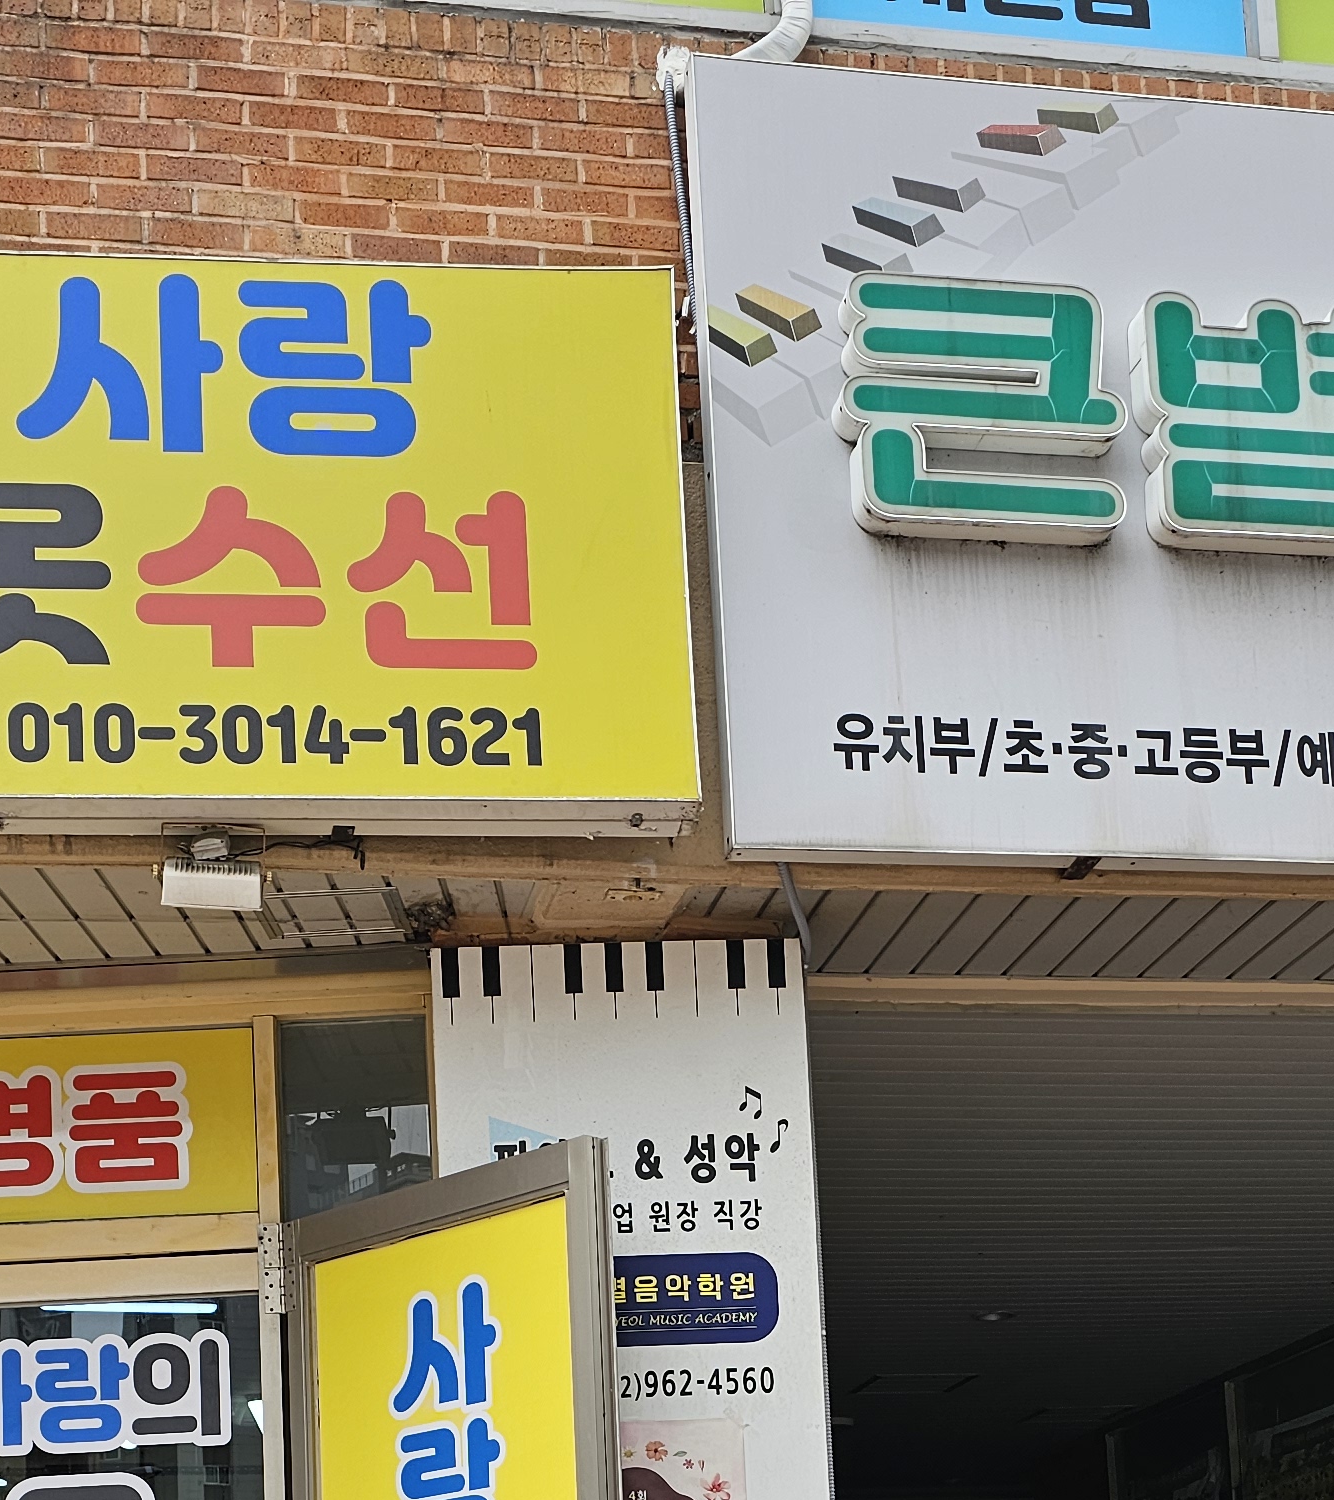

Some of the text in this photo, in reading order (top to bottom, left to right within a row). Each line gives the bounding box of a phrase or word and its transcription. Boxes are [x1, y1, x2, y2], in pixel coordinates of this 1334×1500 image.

[17, 272, 432, 458] 사랑
[8, 702, 544, 768] 010-3014-1621
[683, 1132, 761, 1185] 성악
[648, 1199, 699, 1234] 원장
[712, 1198, 763, 1232] 직강
[649, 1313, 692, 1326] MUSIC
[695, 1311, 758, 1324] ACADEMY
